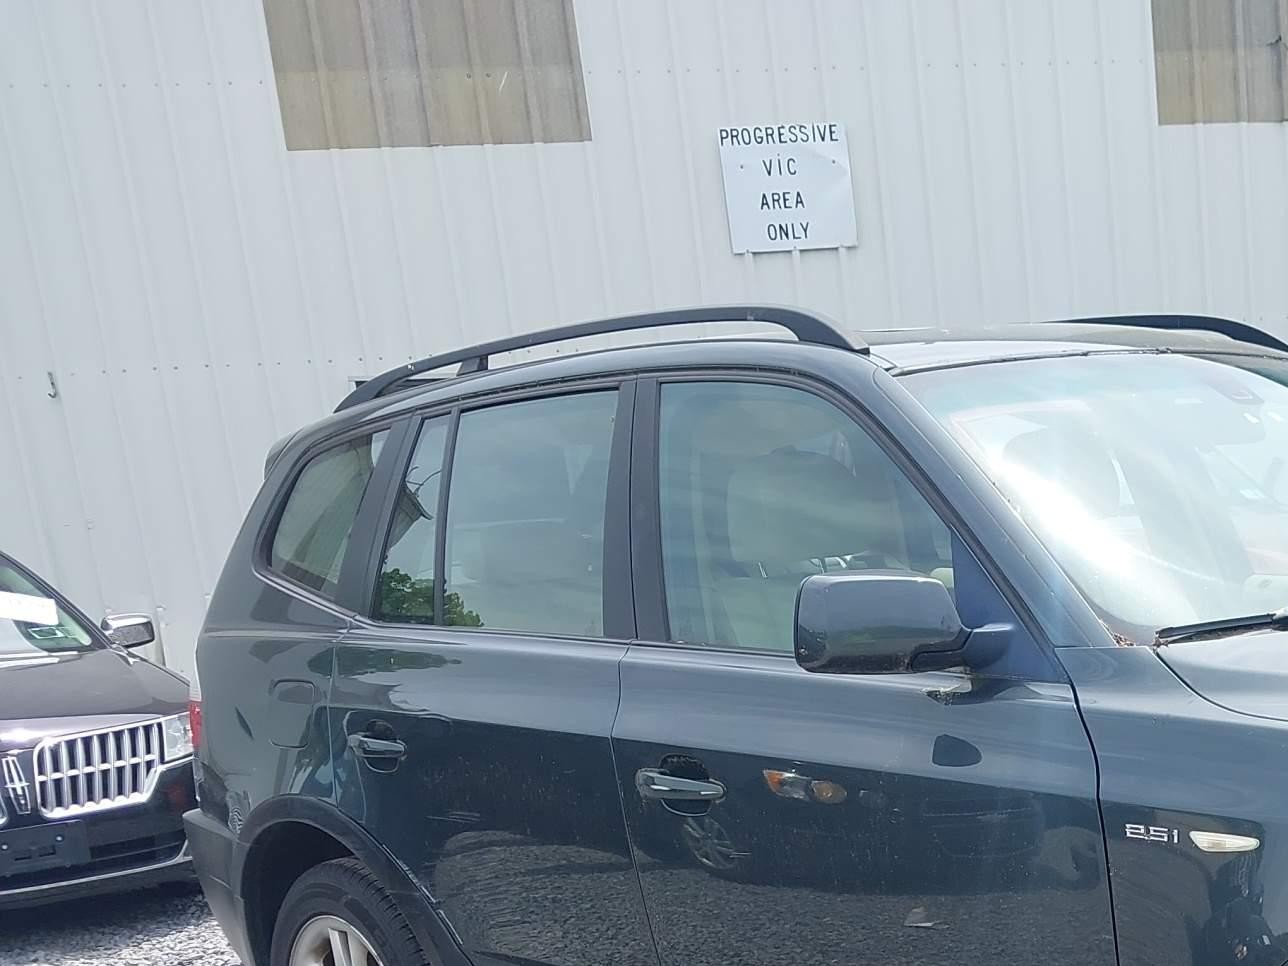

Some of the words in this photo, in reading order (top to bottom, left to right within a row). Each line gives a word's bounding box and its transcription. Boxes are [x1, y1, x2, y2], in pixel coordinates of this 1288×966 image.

[719, 124, 839, 146] PROGRESSIVE
[762, 158, 797, 176] VIC
[760, 191, 805, 210] AREA
[767, 222, 809, 241] ONLY
